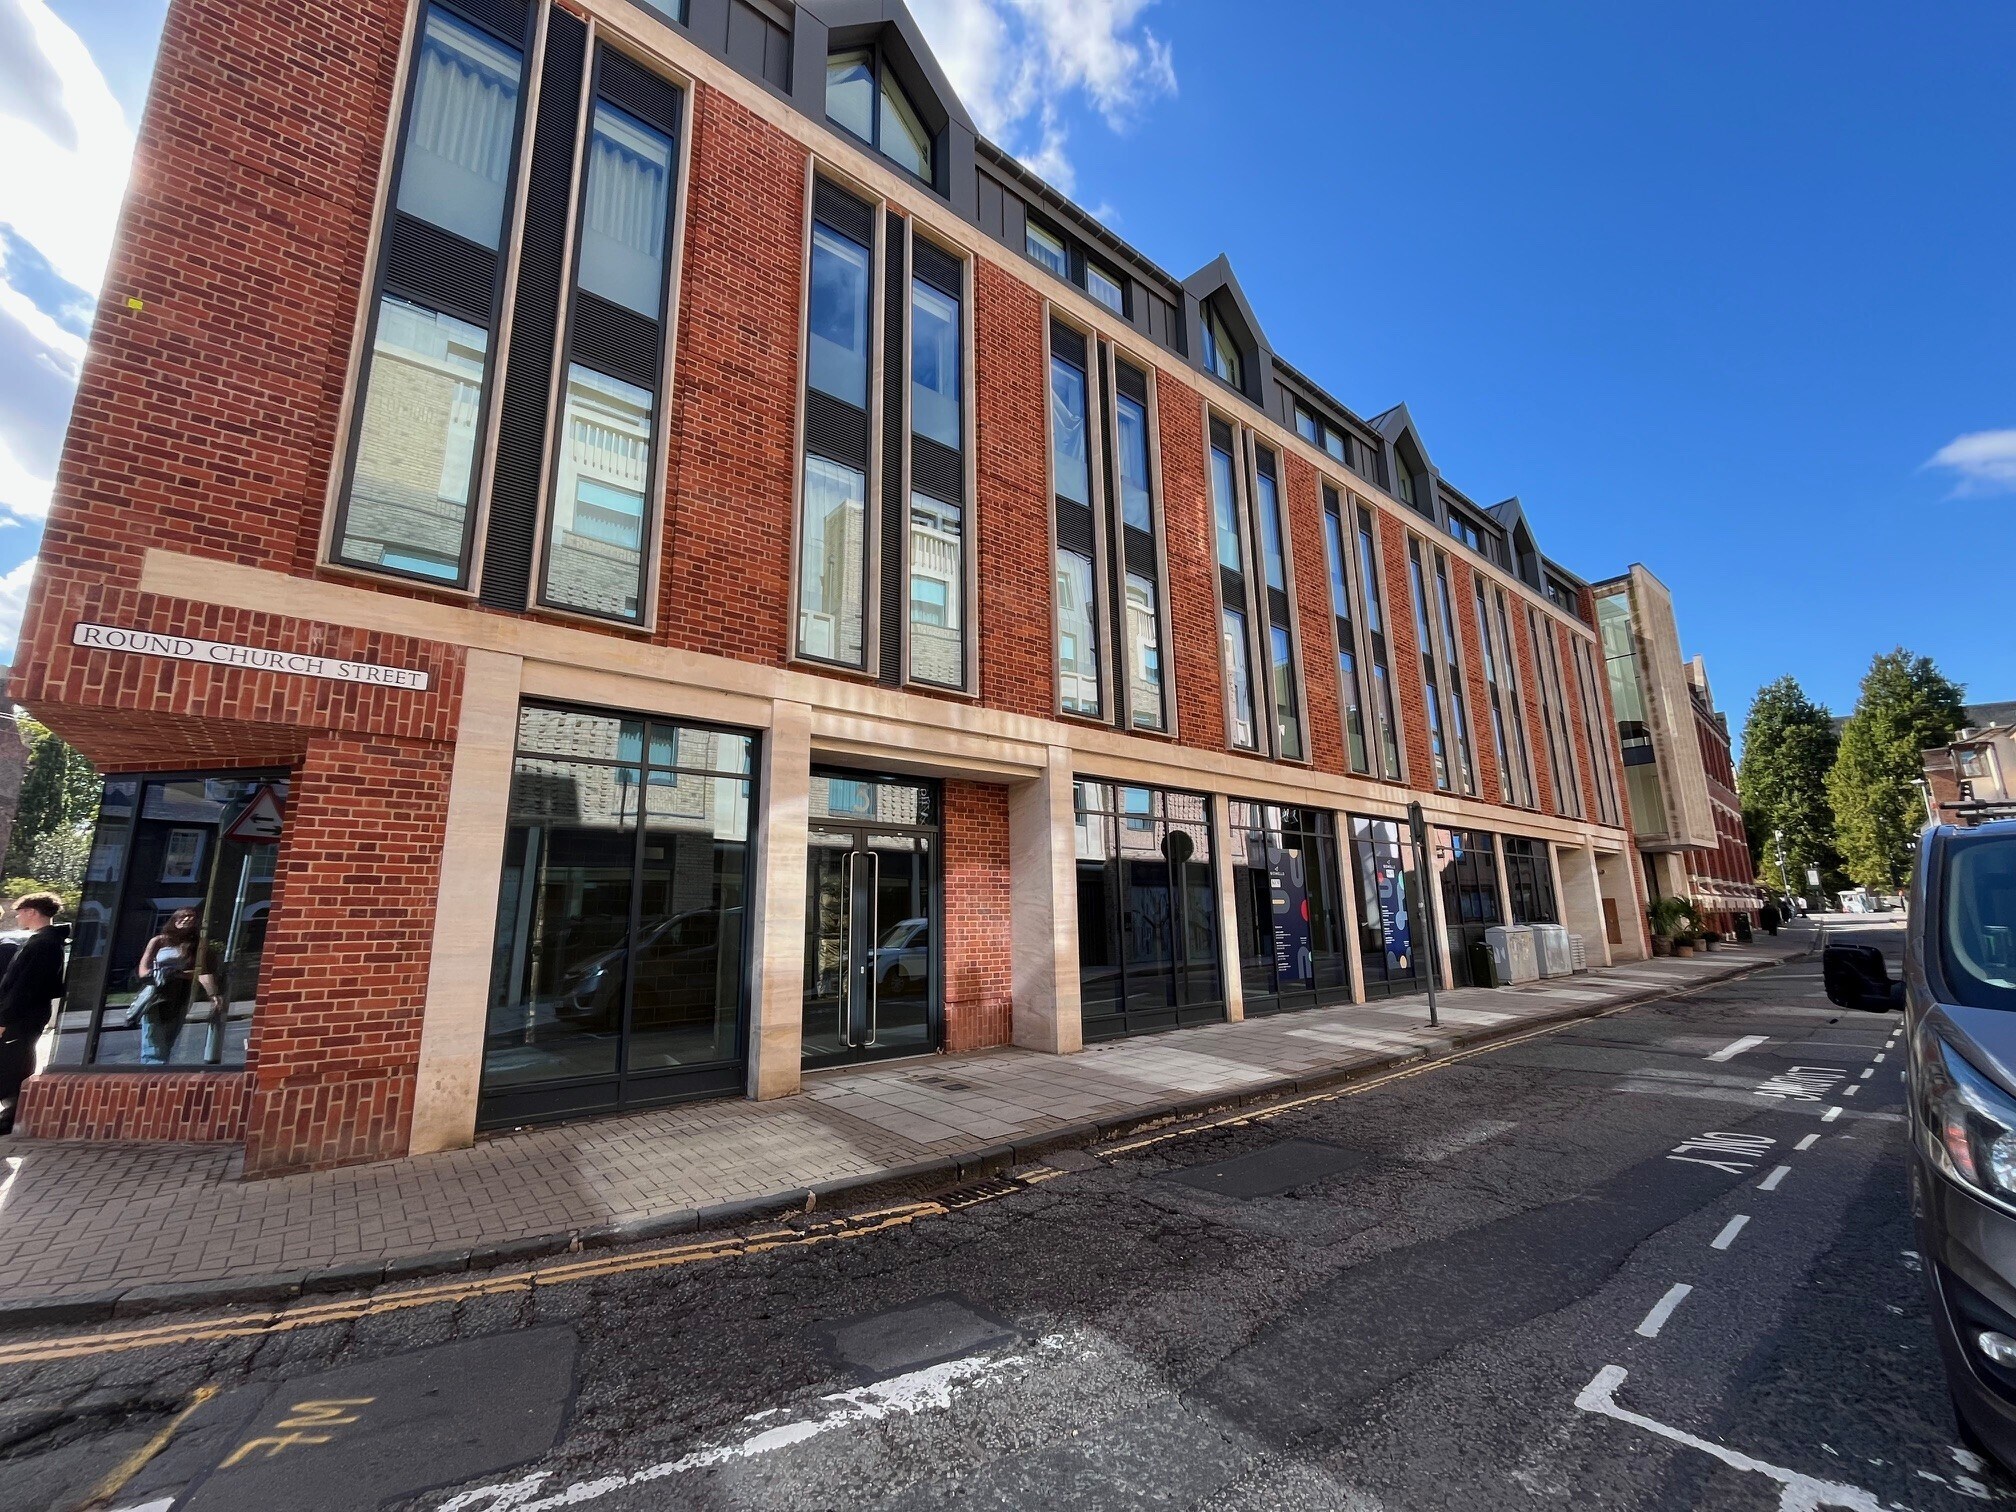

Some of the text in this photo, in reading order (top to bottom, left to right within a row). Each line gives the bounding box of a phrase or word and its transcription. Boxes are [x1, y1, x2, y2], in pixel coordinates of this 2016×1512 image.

[83, 627, 422, 687] ROUND CHURCH STREET
[1665, 1131, 1777, 1175] ONLY
